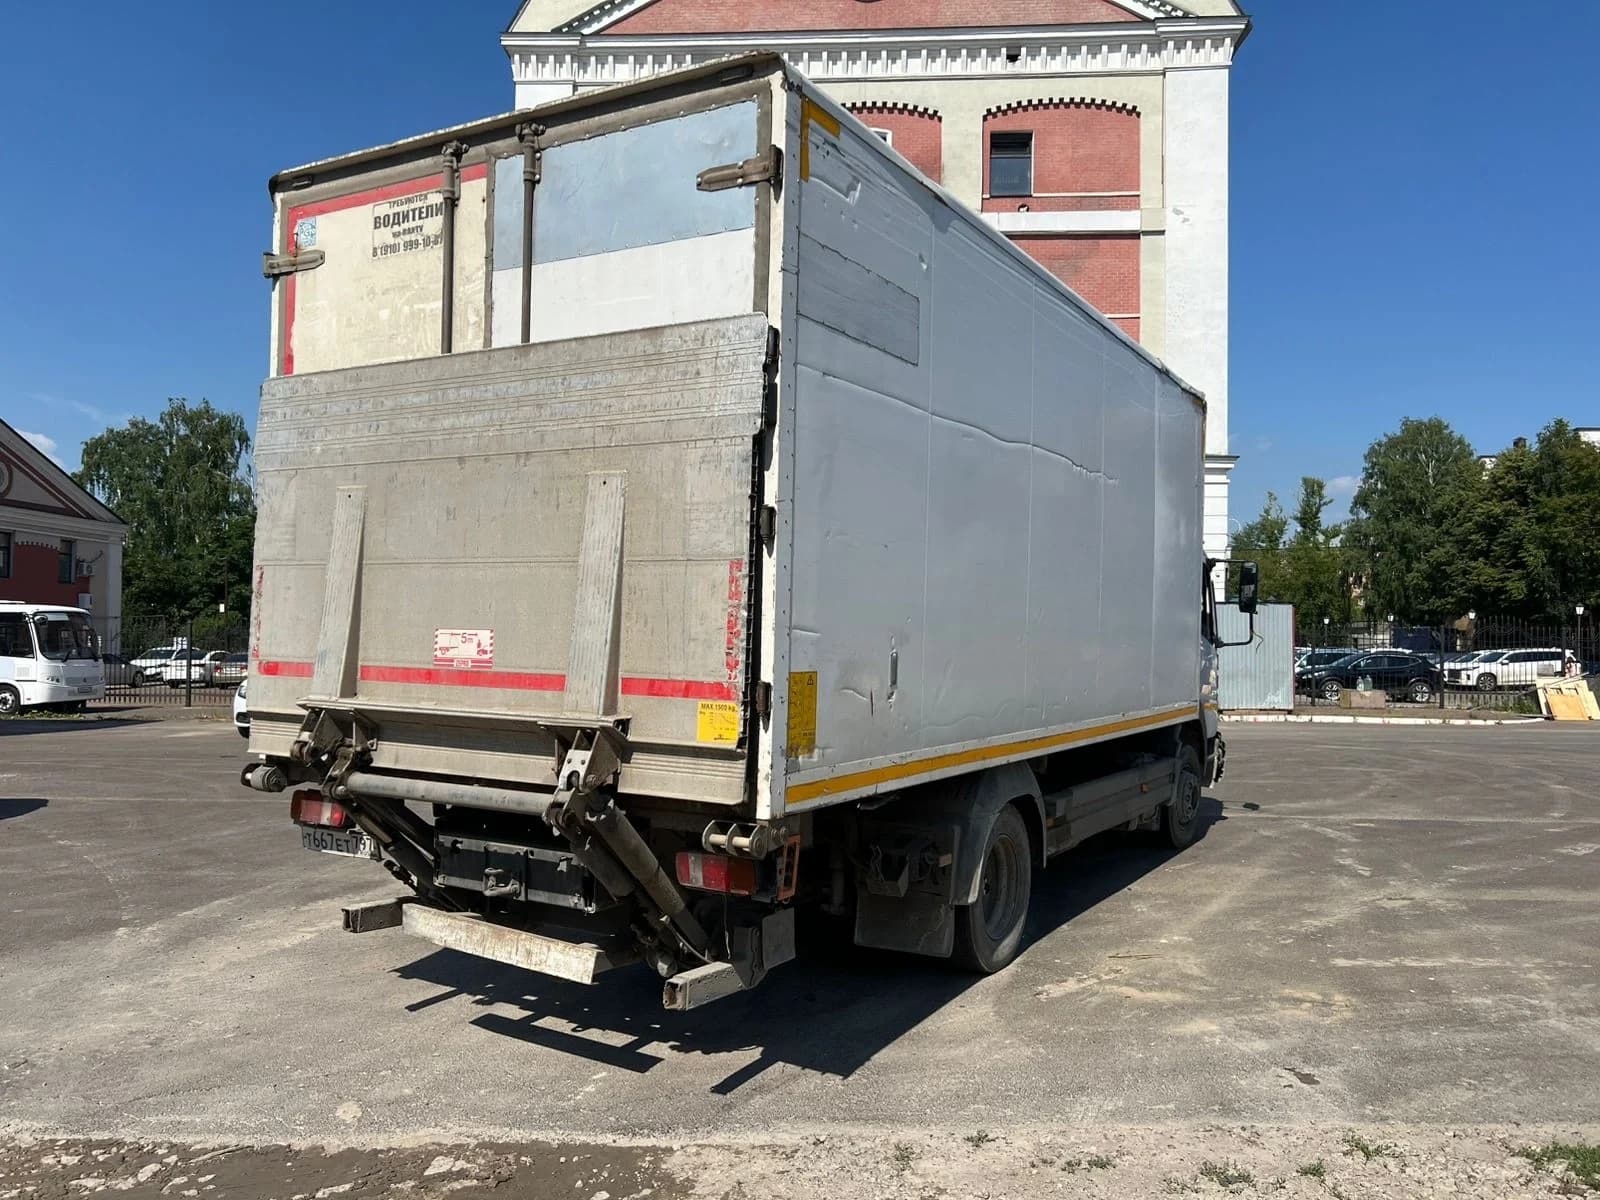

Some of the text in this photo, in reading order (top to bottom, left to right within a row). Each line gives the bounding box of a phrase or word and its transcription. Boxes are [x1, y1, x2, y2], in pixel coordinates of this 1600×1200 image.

[388, 194, 428, 209] ТРЕБУЮТСЯ
[373, 202, 444, 230] ВОДИТЕЛИ
[380, 242, 401, 256] (910)
